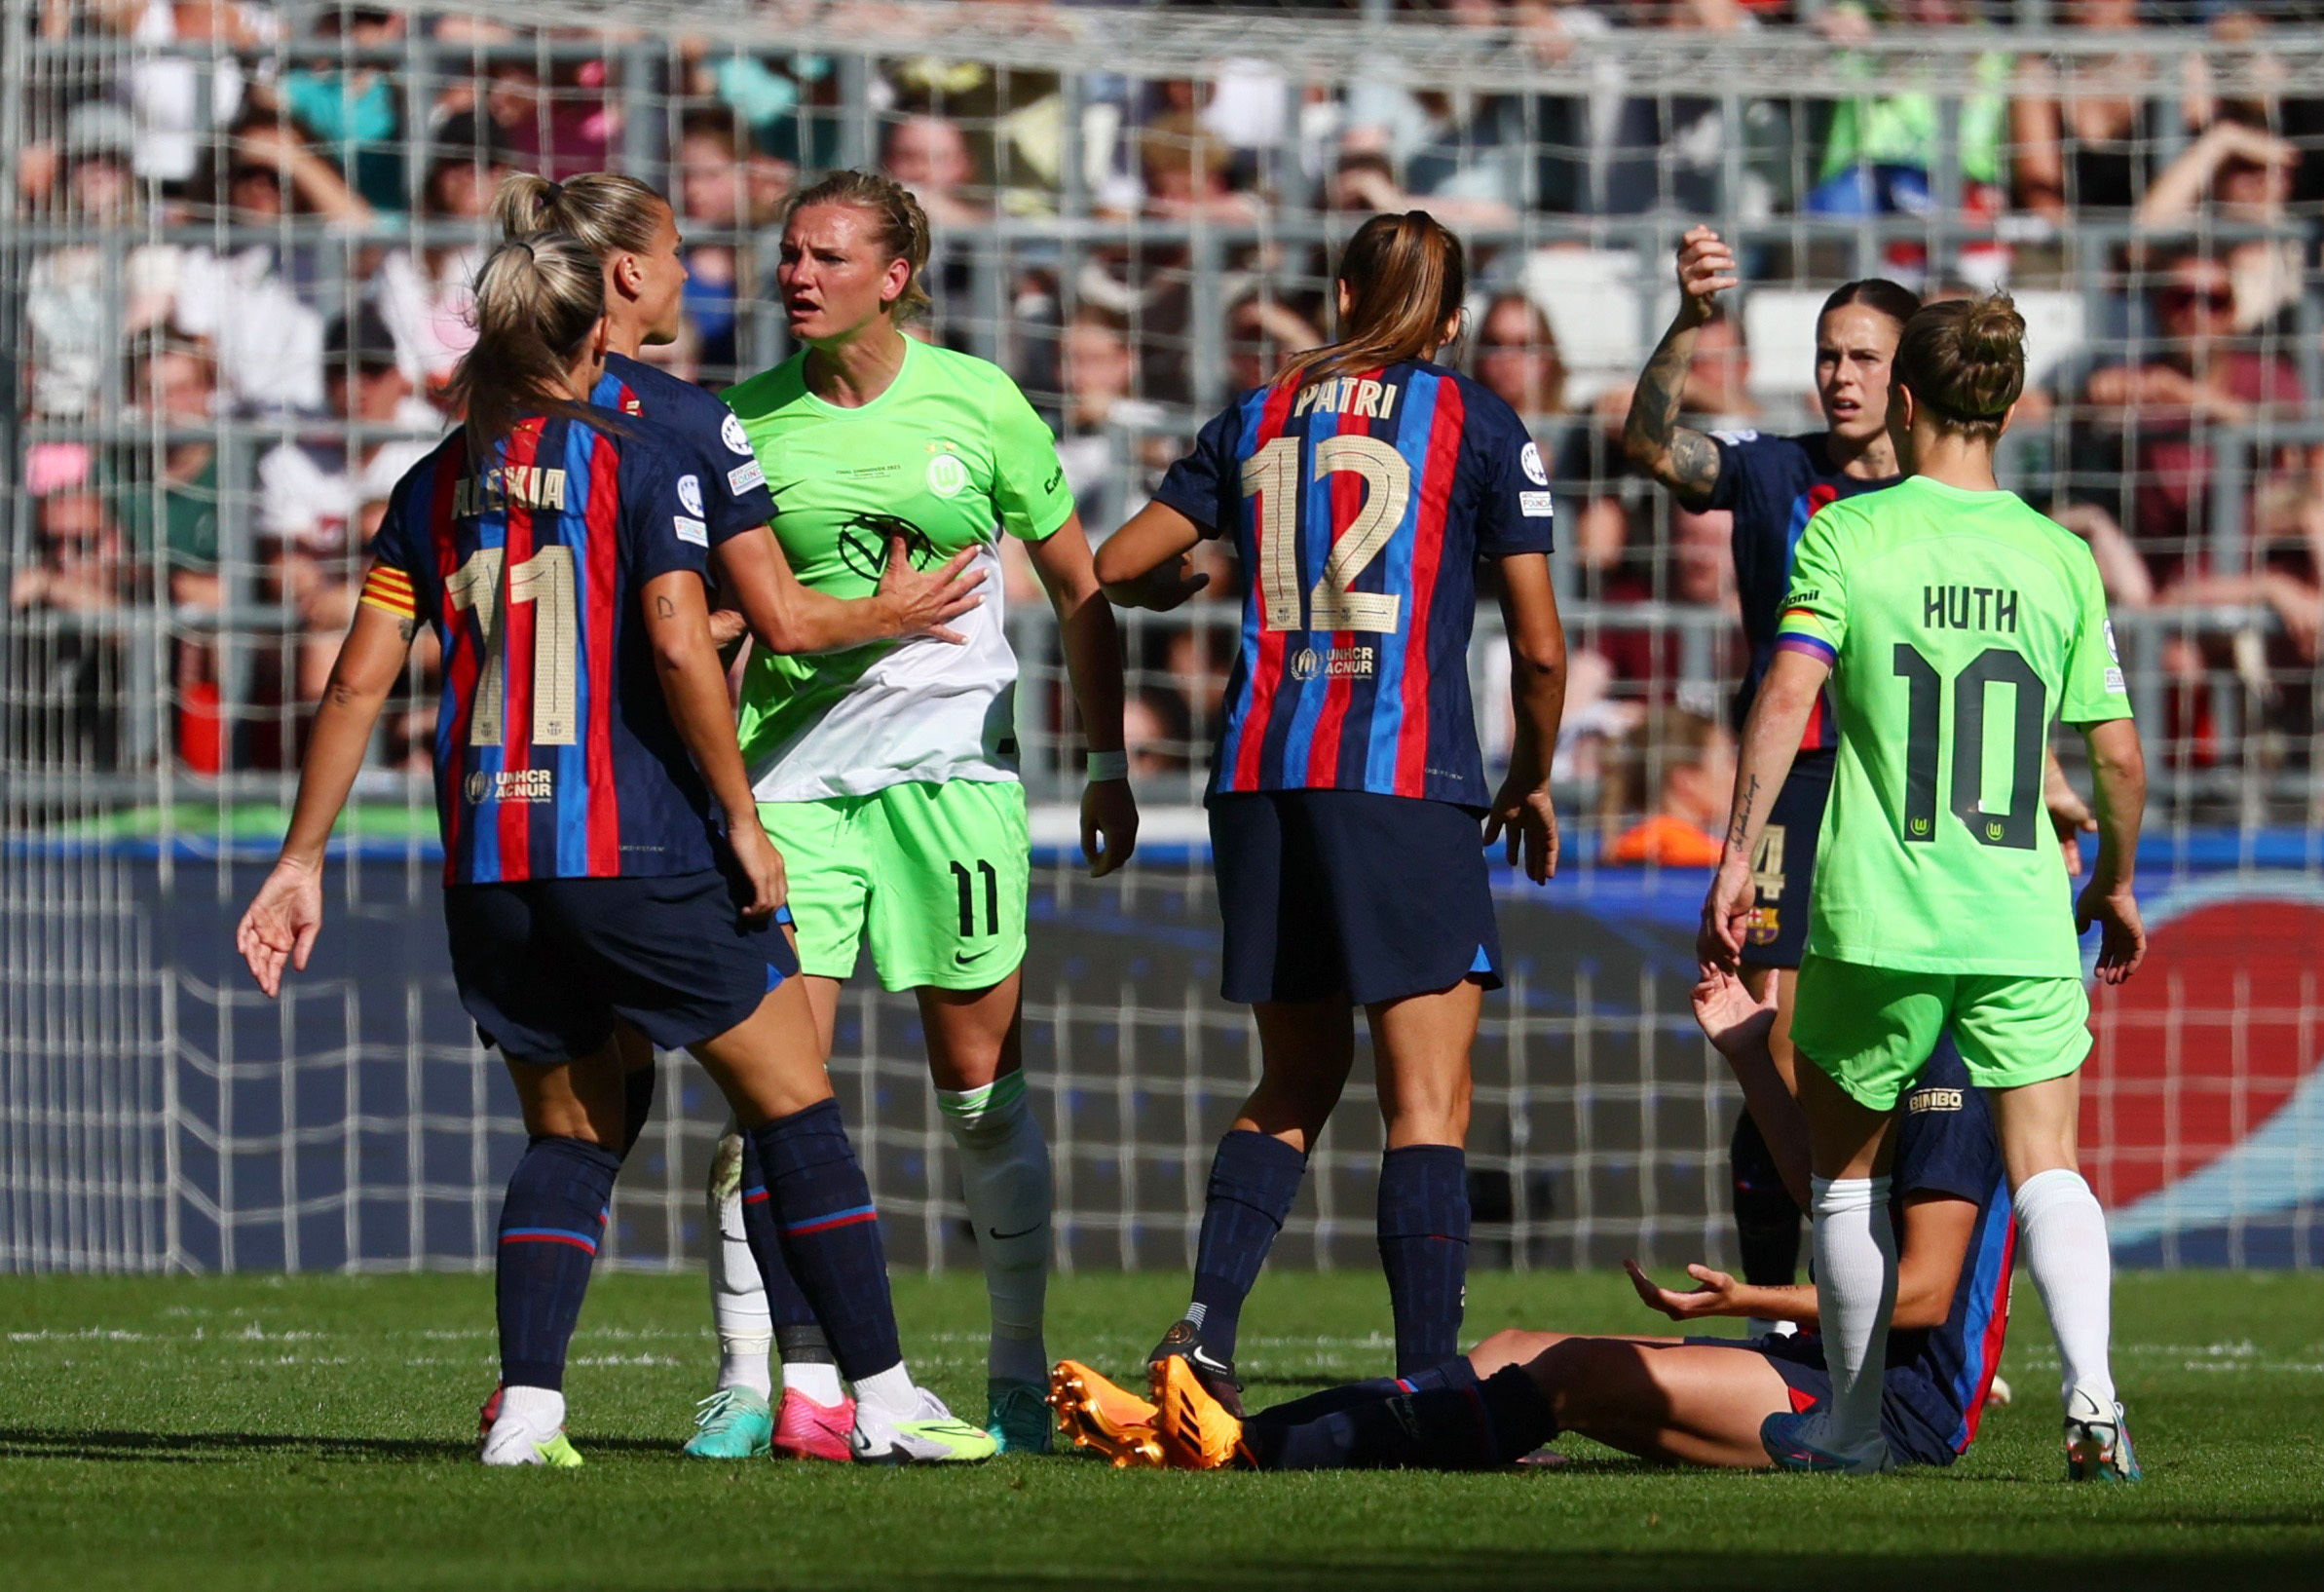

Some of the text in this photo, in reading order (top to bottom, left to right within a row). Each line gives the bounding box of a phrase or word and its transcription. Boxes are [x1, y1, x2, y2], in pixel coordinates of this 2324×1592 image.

[1293, 377, 1398, 420] PATRI
[451, 466, 566, 520] ALEXIA
[1241, 435, 1410, 634] 12
[1924, 585, 2018, 633] HUTH
[445, 546, 577, 746] 11
[1324, 661, 1373, 675] ACNUR
[1326, 646, 1374, 662] UNHCR
[1893, 642, 2046, 851] 10
[494, 783, 552, 799] ACNUR
[495, 769, 552, 786] UNHCR
[950, 858, 999, 938] 11
[1910, 1091, 1963, 1111] BIMBO
